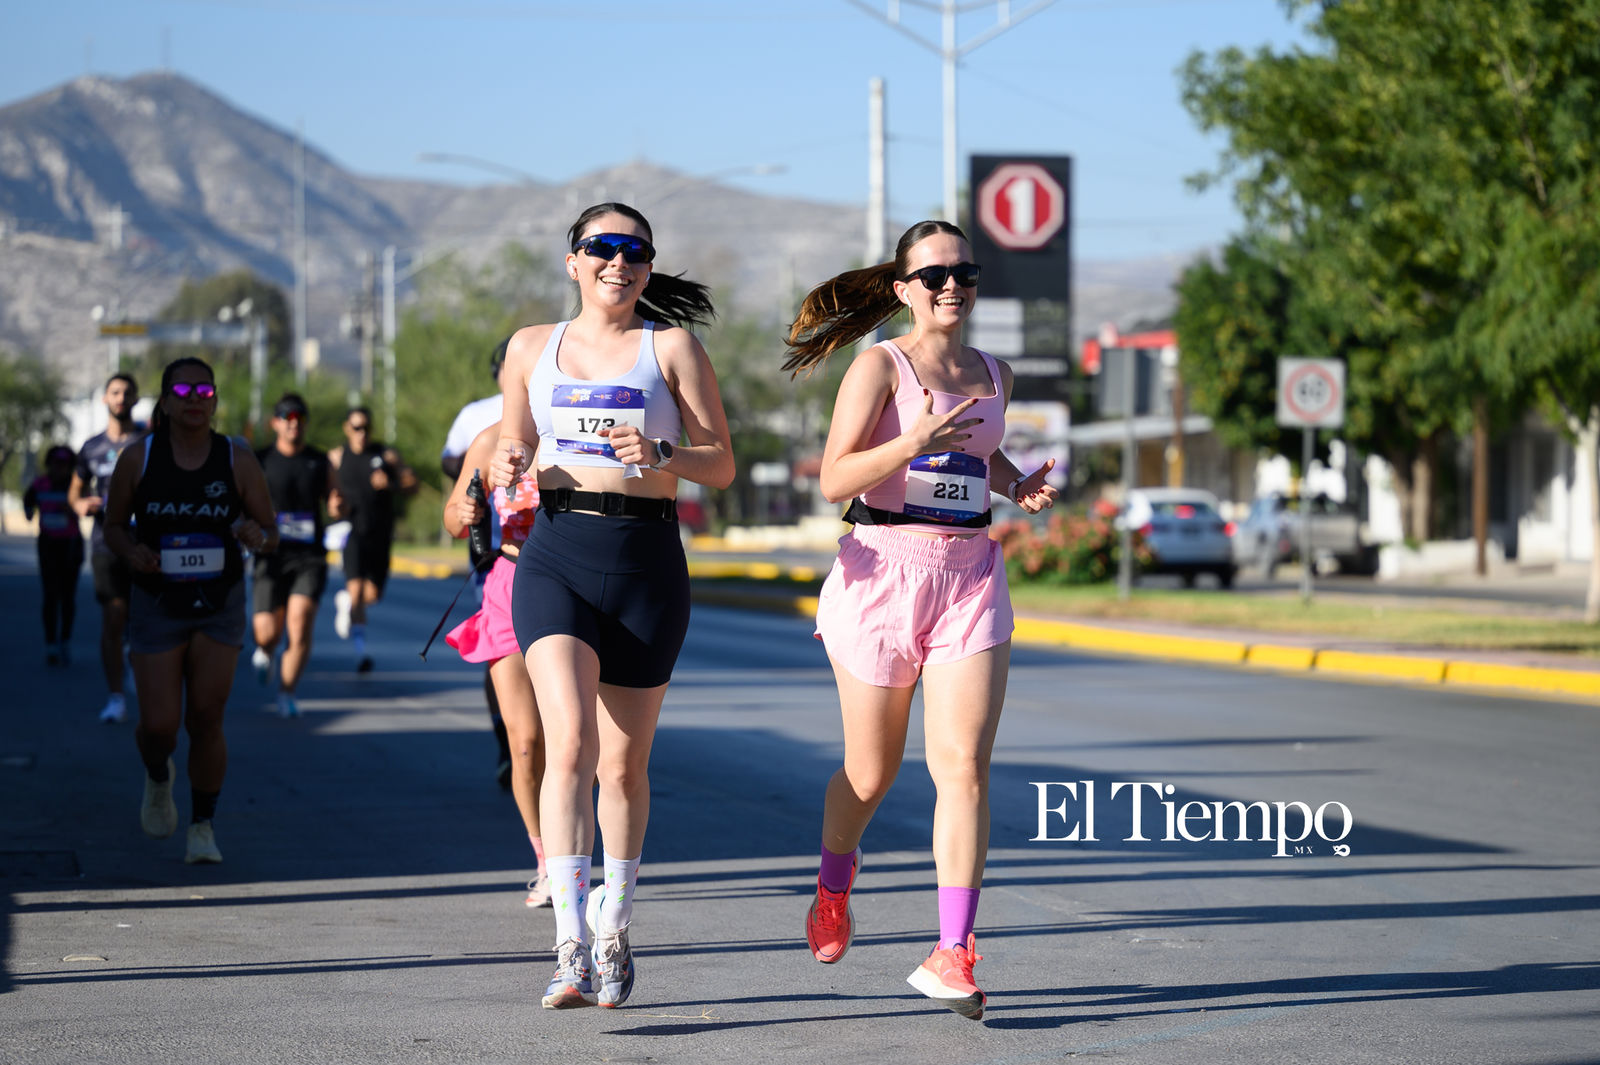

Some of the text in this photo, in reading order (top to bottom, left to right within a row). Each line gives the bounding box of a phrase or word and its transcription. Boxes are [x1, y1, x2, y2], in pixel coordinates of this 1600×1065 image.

[1004, 175, 1036, 235] 1
[933, 482, 969, 500] 221
[146, 502, 229, 517] RAKAN
[180, 555, 206, 567] 101
